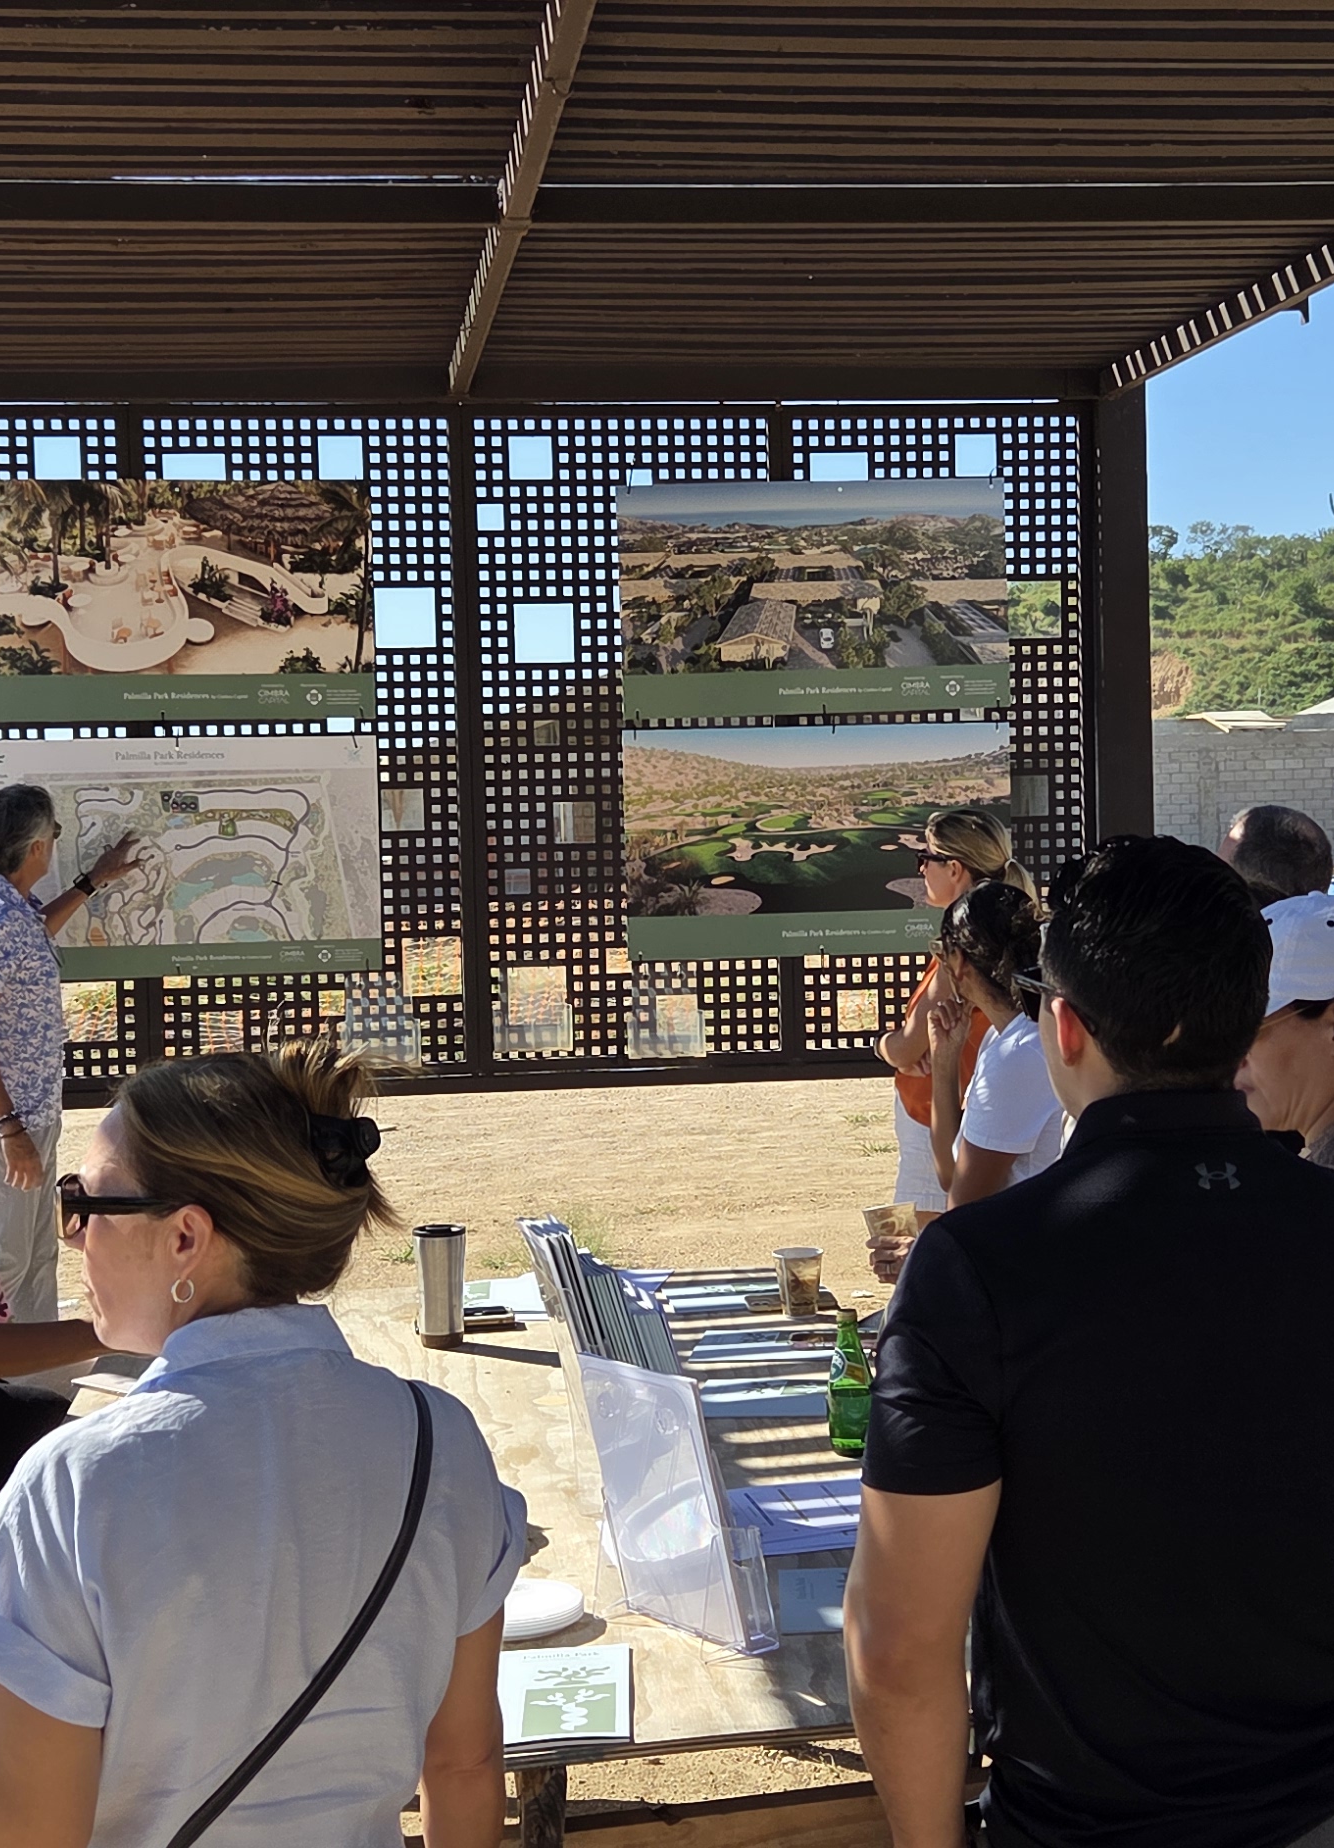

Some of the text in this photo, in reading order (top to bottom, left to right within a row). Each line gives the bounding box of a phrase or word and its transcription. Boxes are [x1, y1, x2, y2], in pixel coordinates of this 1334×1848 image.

[900, 681, 930, 689] CIMBRA
[257, 689, 290, 697] CIMBRA
[805, 686, 820, 695] Park
[153, 691, 169, 700] Park
[115, 750, 225, 761] Palmilla Park Residences
[809, 929, 823, 937] Park
